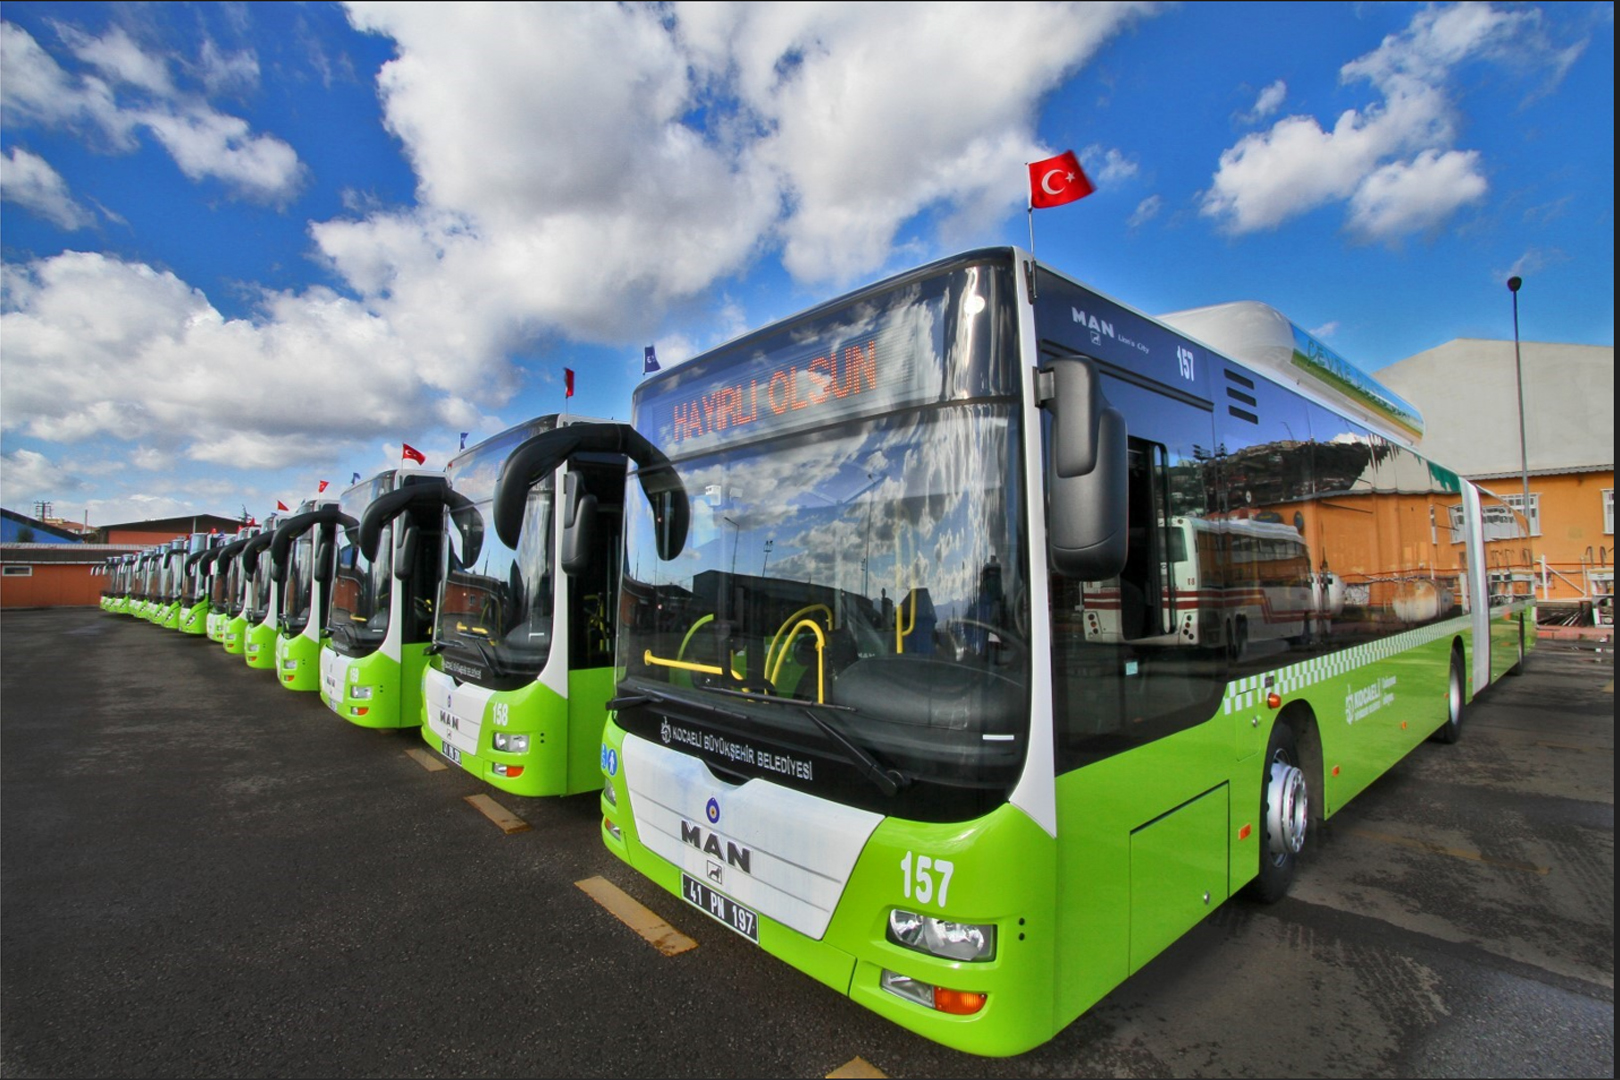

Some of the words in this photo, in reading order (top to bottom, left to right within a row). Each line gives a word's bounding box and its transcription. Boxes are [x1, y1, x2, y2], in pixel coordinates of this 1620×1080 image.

[1071, 306, 1115, 339] MAN
[1117, 333, 1136, 348] Lion's
[1136, 341, 1150, 355] City
[1176, 345, 1195, 382] 157
[673, 379, 758, 441] HAYIRLI
[768, 340, 877, 416] OLSUN
[440, 709, 459, 731] MAN
[492, 701, 509, 727] 158
[672, 726, 703, 749] KOCAELİ
[703, 733, 756, 765] BÜYÜKŞEHİR
[757, 750, 814, 781] BELEDİYESİ
[680, 819, 753, 875] MAN
[900, 850, 955, 908] 157
[690, 880, 703, 906] 41
[709, 891, 725, 920] PN
[732, 904, 754, 935] 197
